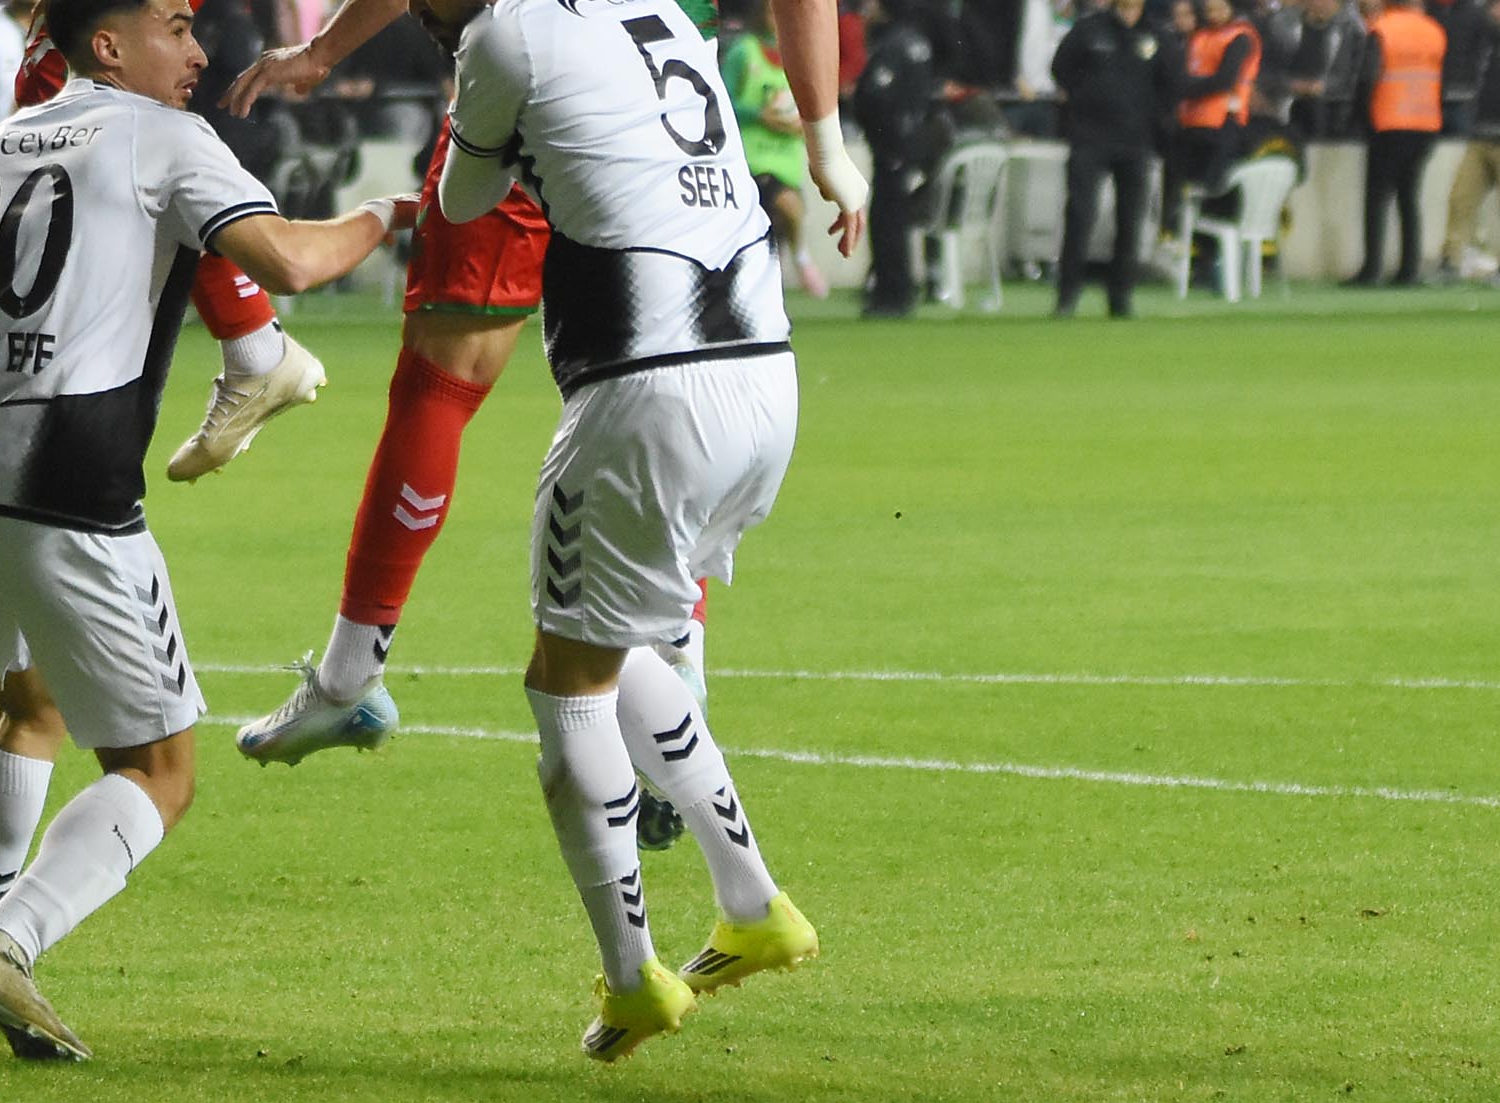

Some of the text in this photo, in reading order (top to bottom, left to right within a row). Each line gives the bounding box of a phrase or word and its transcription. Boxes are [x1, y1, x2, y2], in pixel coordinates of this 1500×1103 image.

[620, 14, 726, 157] 5
[678, 165, 740, 209] SEFA
[5, 332, 56, 375] EFE
